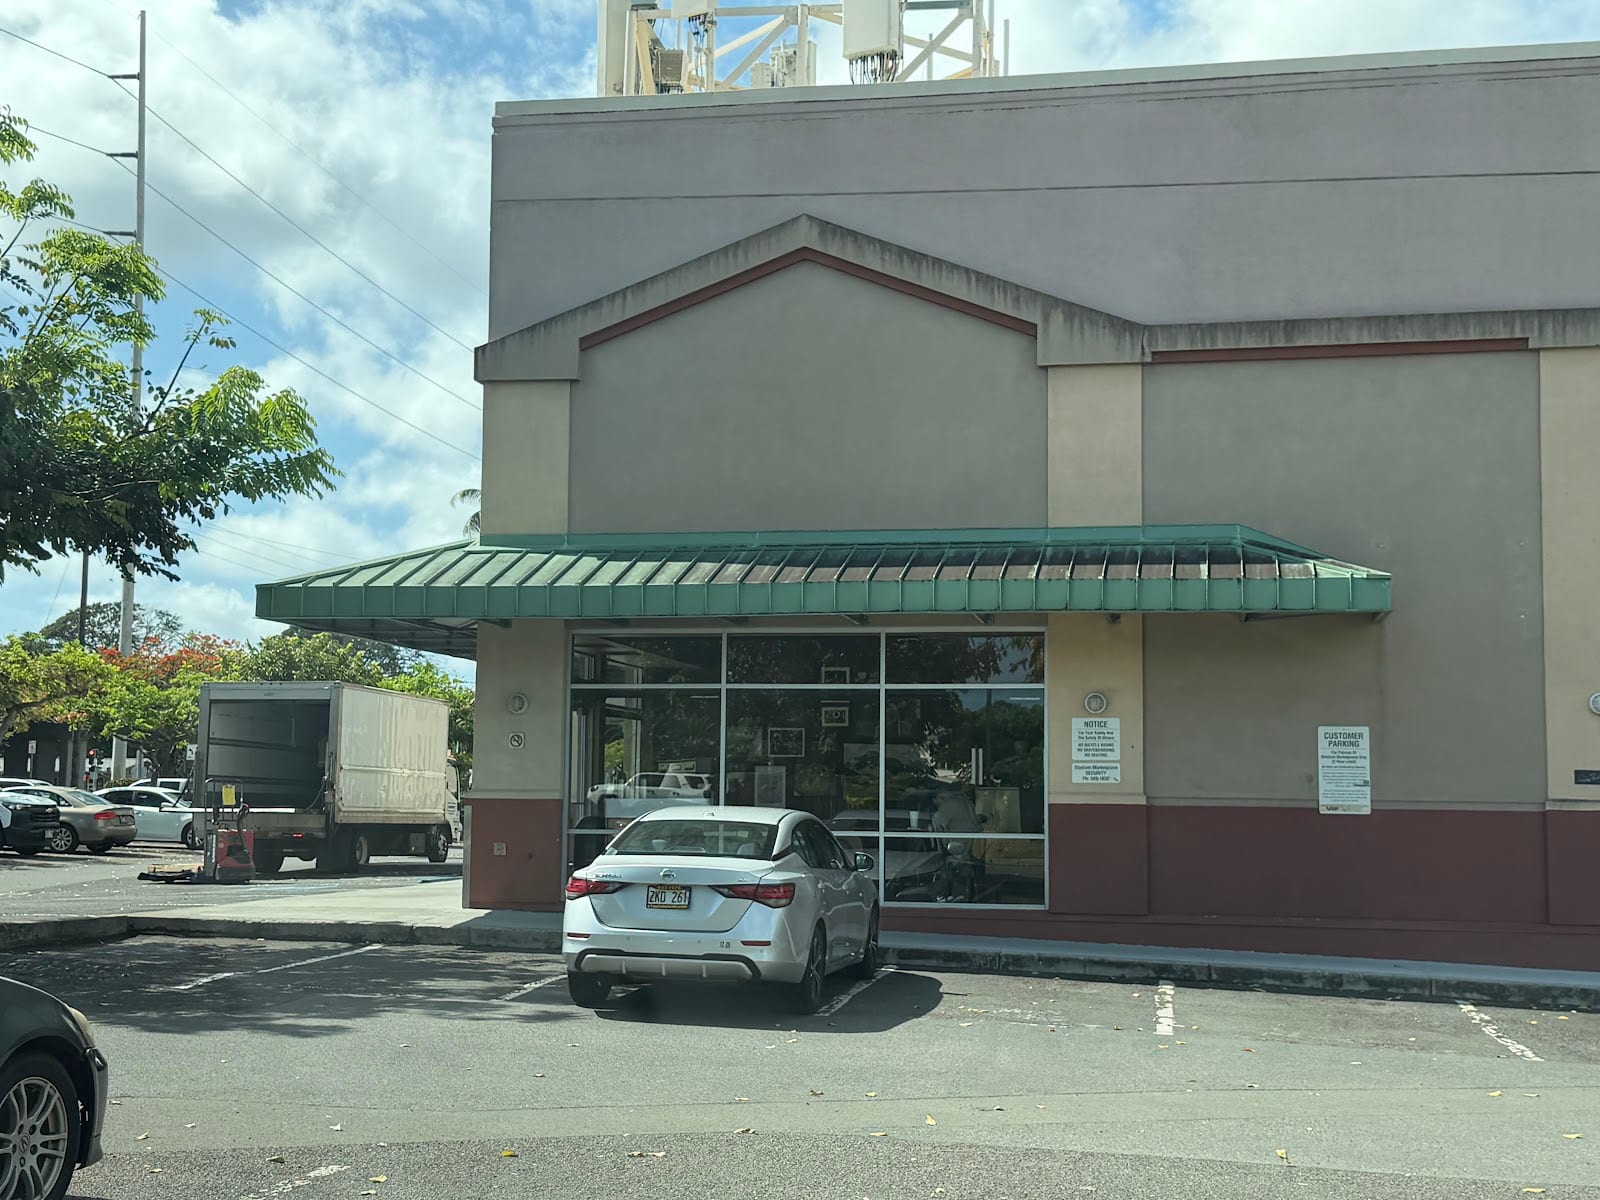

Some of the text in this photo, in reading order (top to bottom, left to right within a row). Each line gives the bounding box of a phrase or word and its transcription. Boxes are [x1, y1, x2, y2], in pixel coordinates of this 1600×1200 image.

[1083, 720, 1108, 728] NOTICE
[1324, 732, 1364, 740] CUSTOMER
[1328, 740, 1360, 748] PARKING
[671, 891, 687, 903] 261
